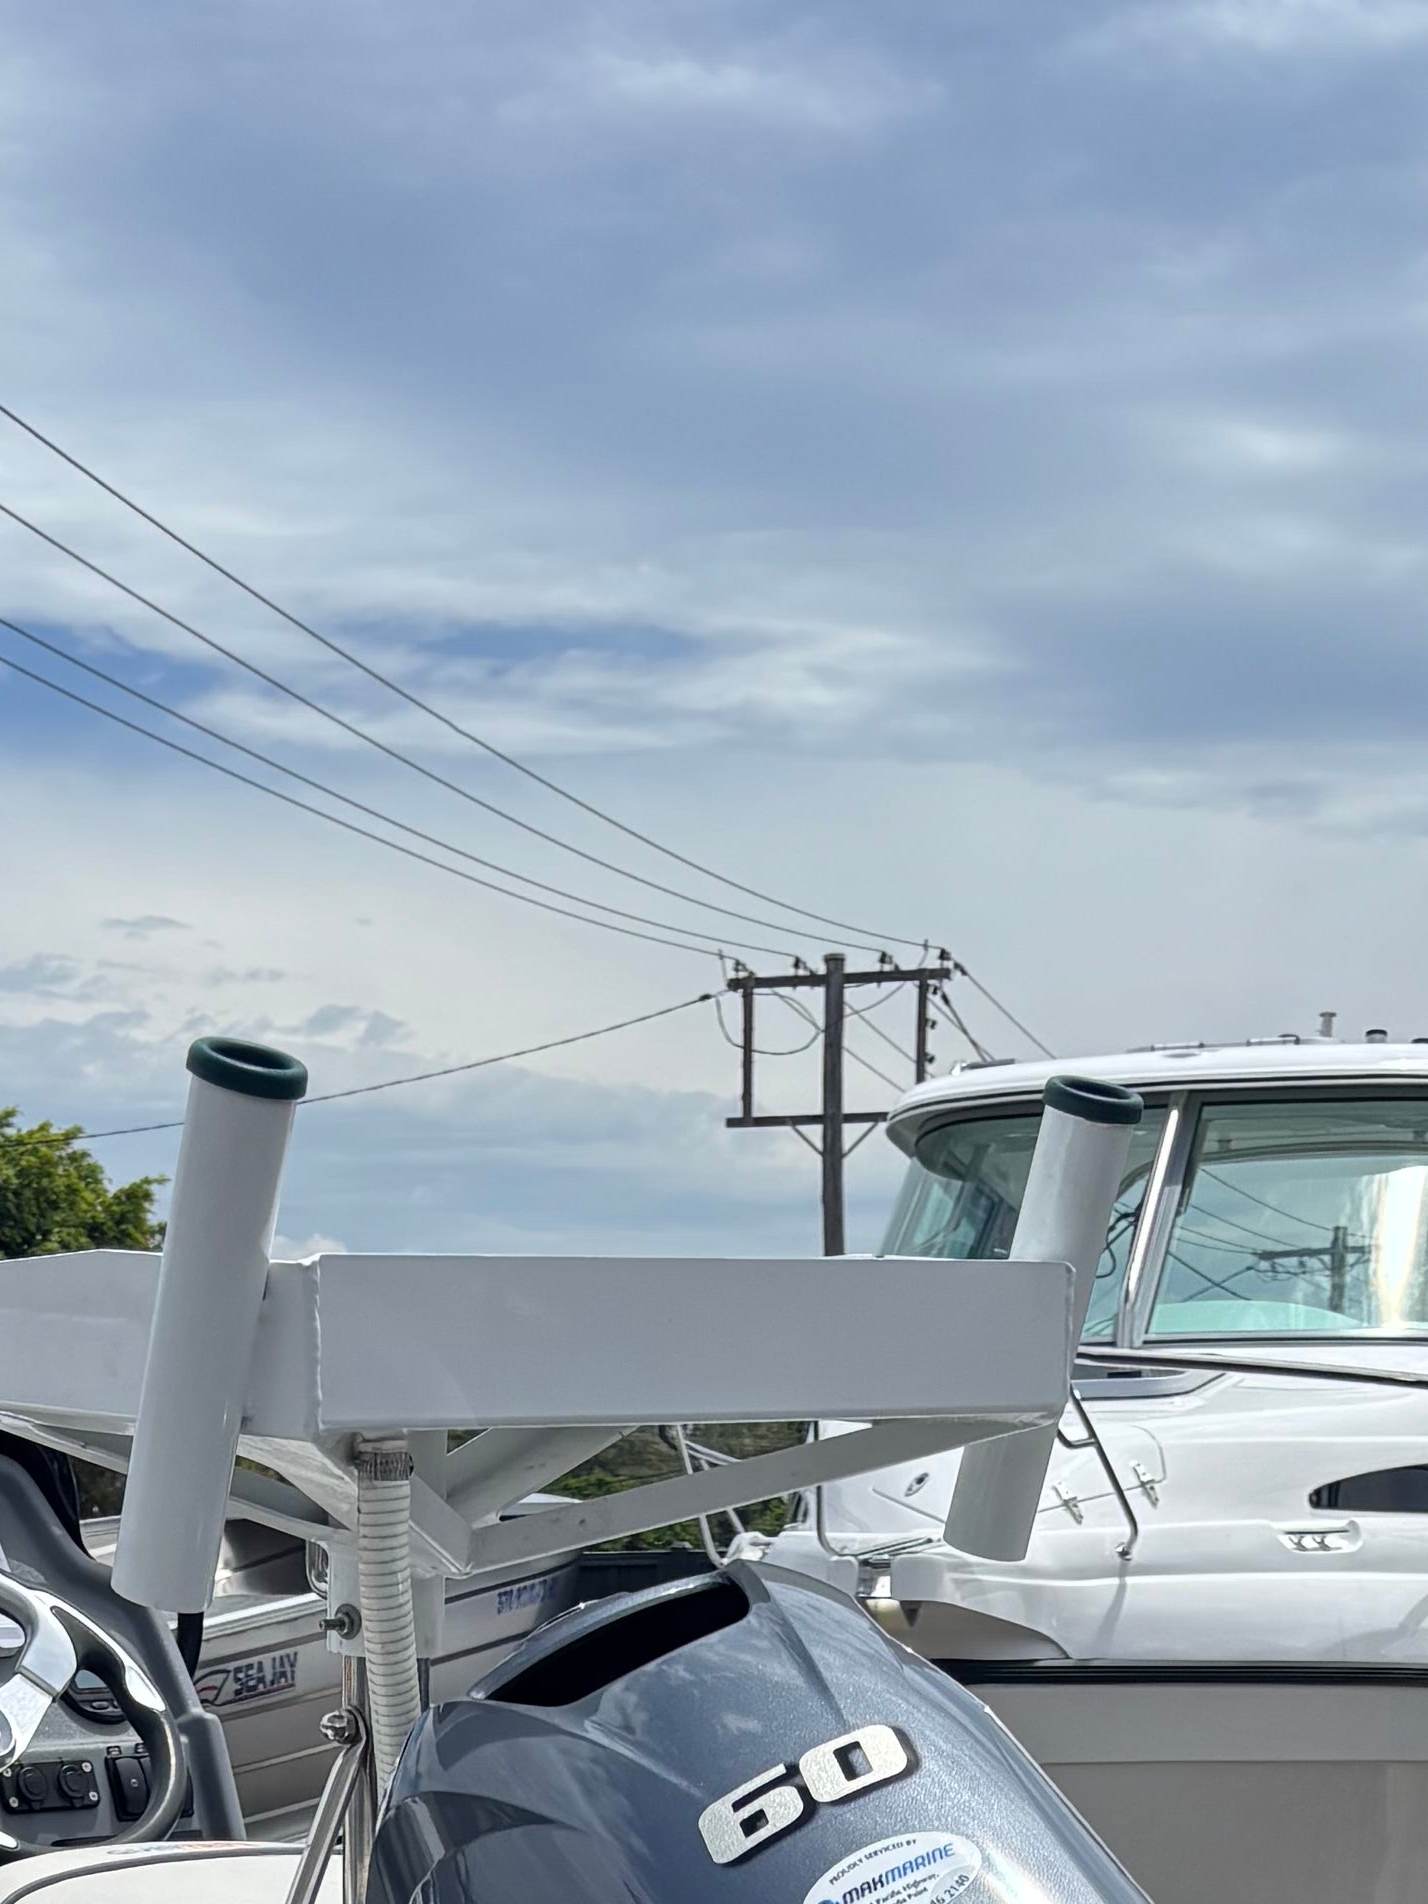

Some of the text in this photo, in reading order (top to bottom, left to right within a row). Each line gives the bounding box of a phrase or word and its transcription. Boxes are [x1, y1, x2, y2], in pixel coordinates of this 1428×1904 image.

[232, 1651, 299, 1695] SEA JAY
[698, 1724, 908, 1864] 60
[829, 1857, 864, 1886] PROUDLY
